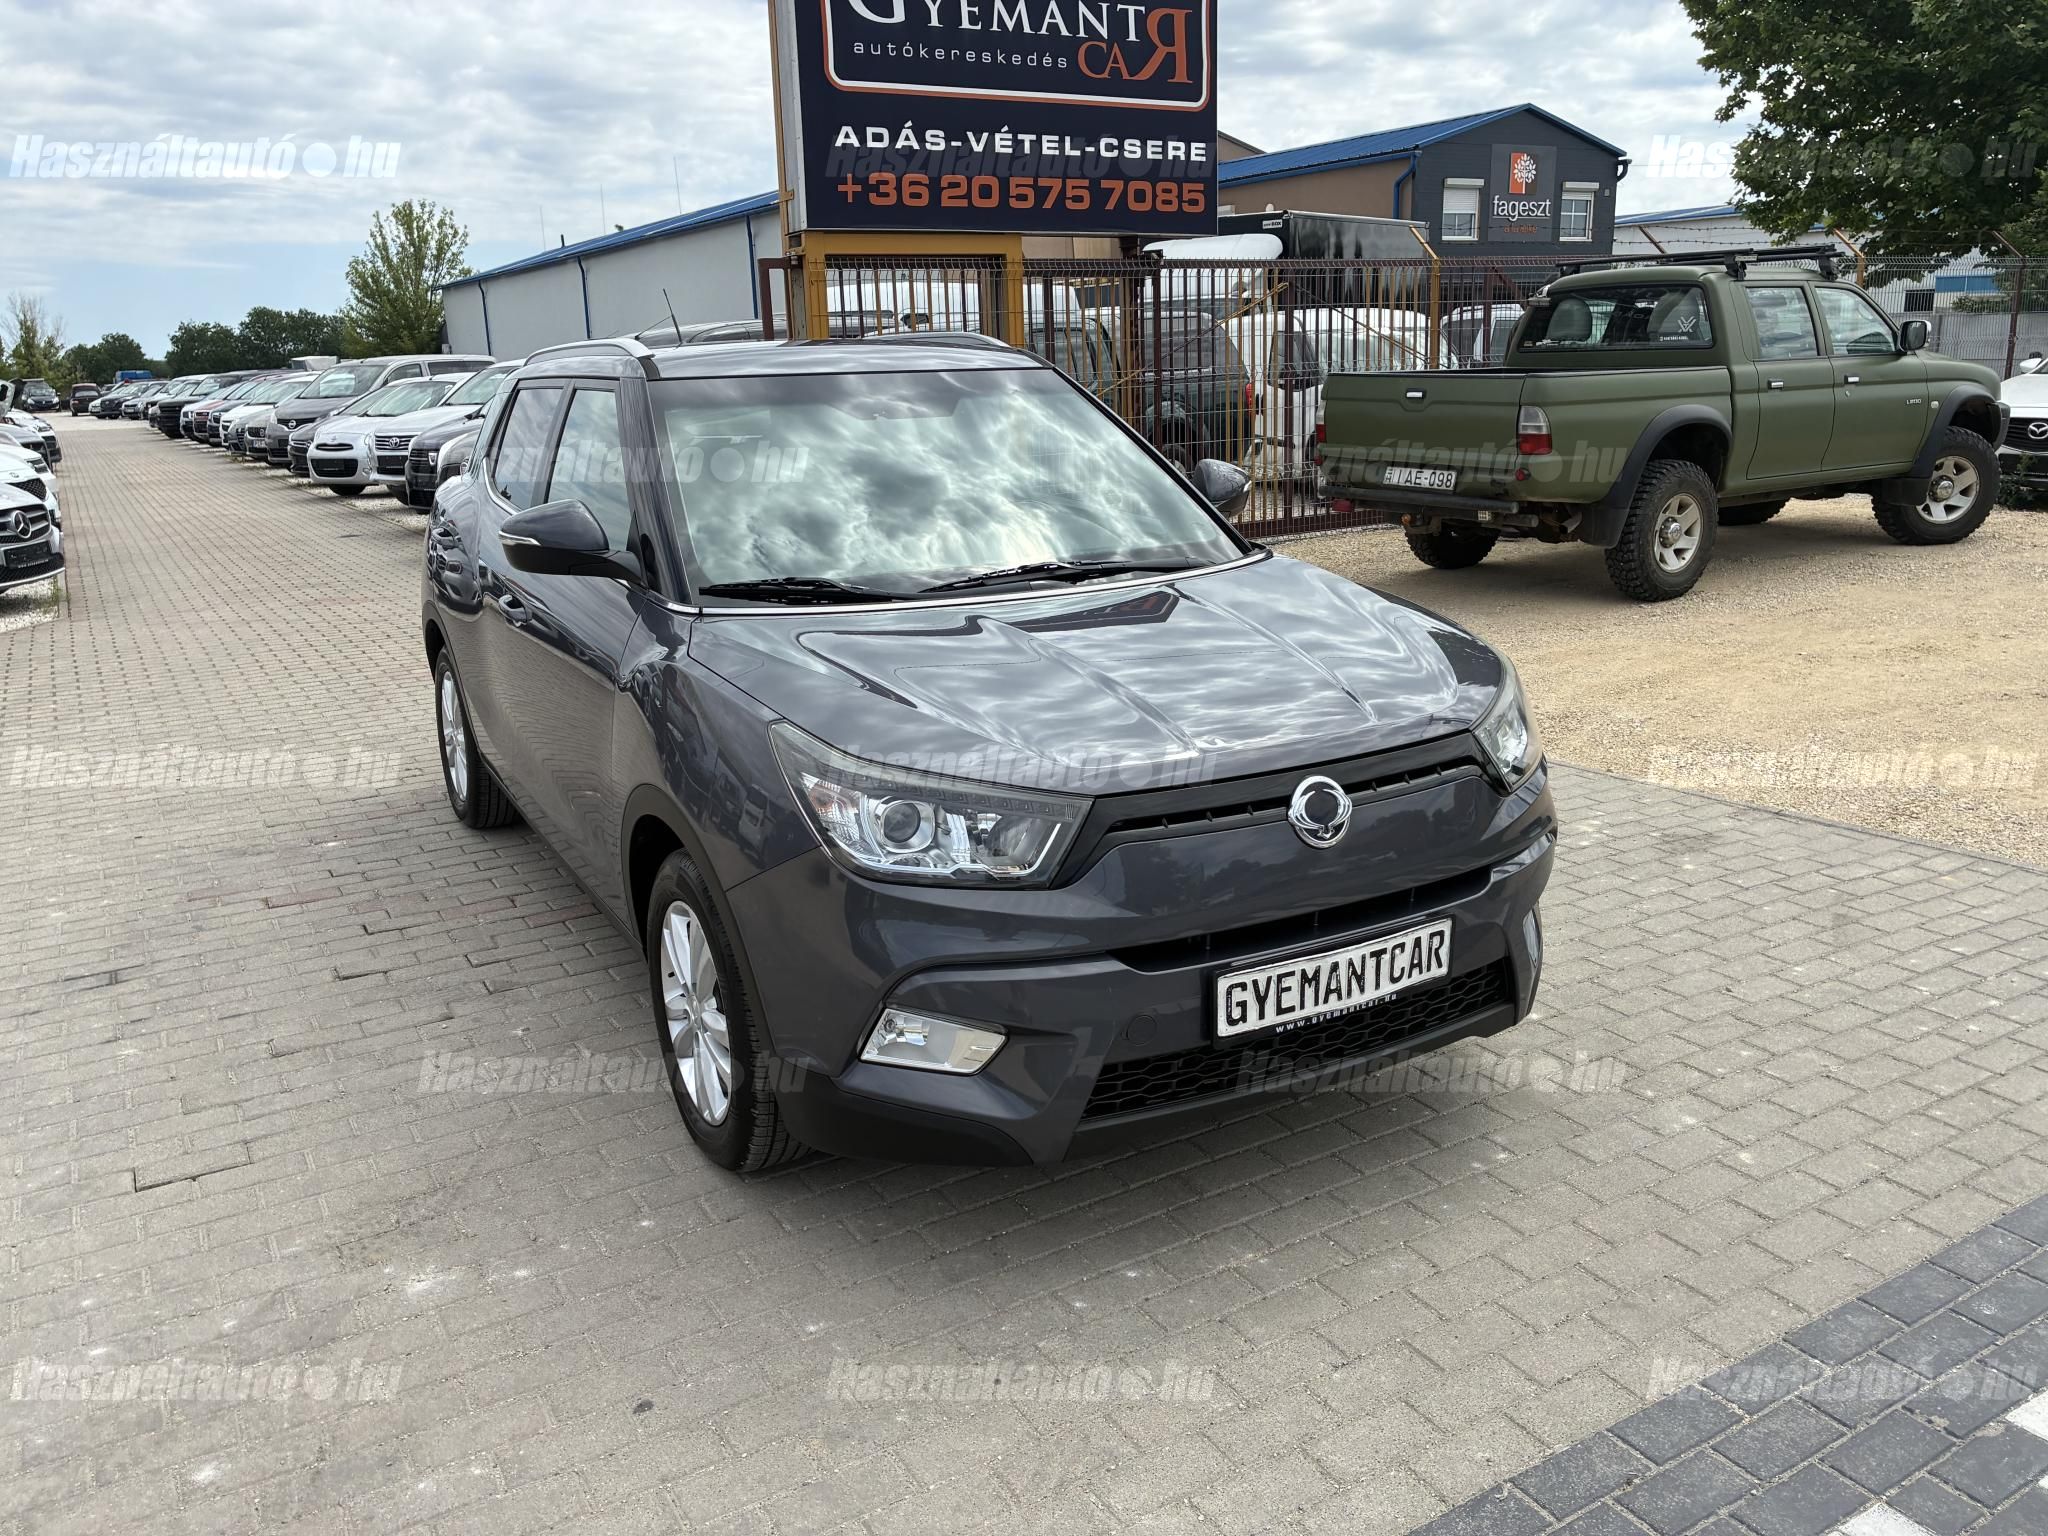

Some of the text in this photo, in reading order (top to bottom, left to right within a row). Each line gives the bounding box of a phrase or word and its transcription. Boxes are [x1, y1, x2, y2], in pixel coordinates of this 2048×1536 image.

[853, 40, 1068, 69] autókereskedés
[834, 121, 1207, 162] ADÁS-VÉTEL-CSERE
[837, 171, 1206, 214] +36 20 575 7085
[1492, 195, 1552, 222] fageszt
[1225, 929, 1446, 1027] GYEMANTCAR
